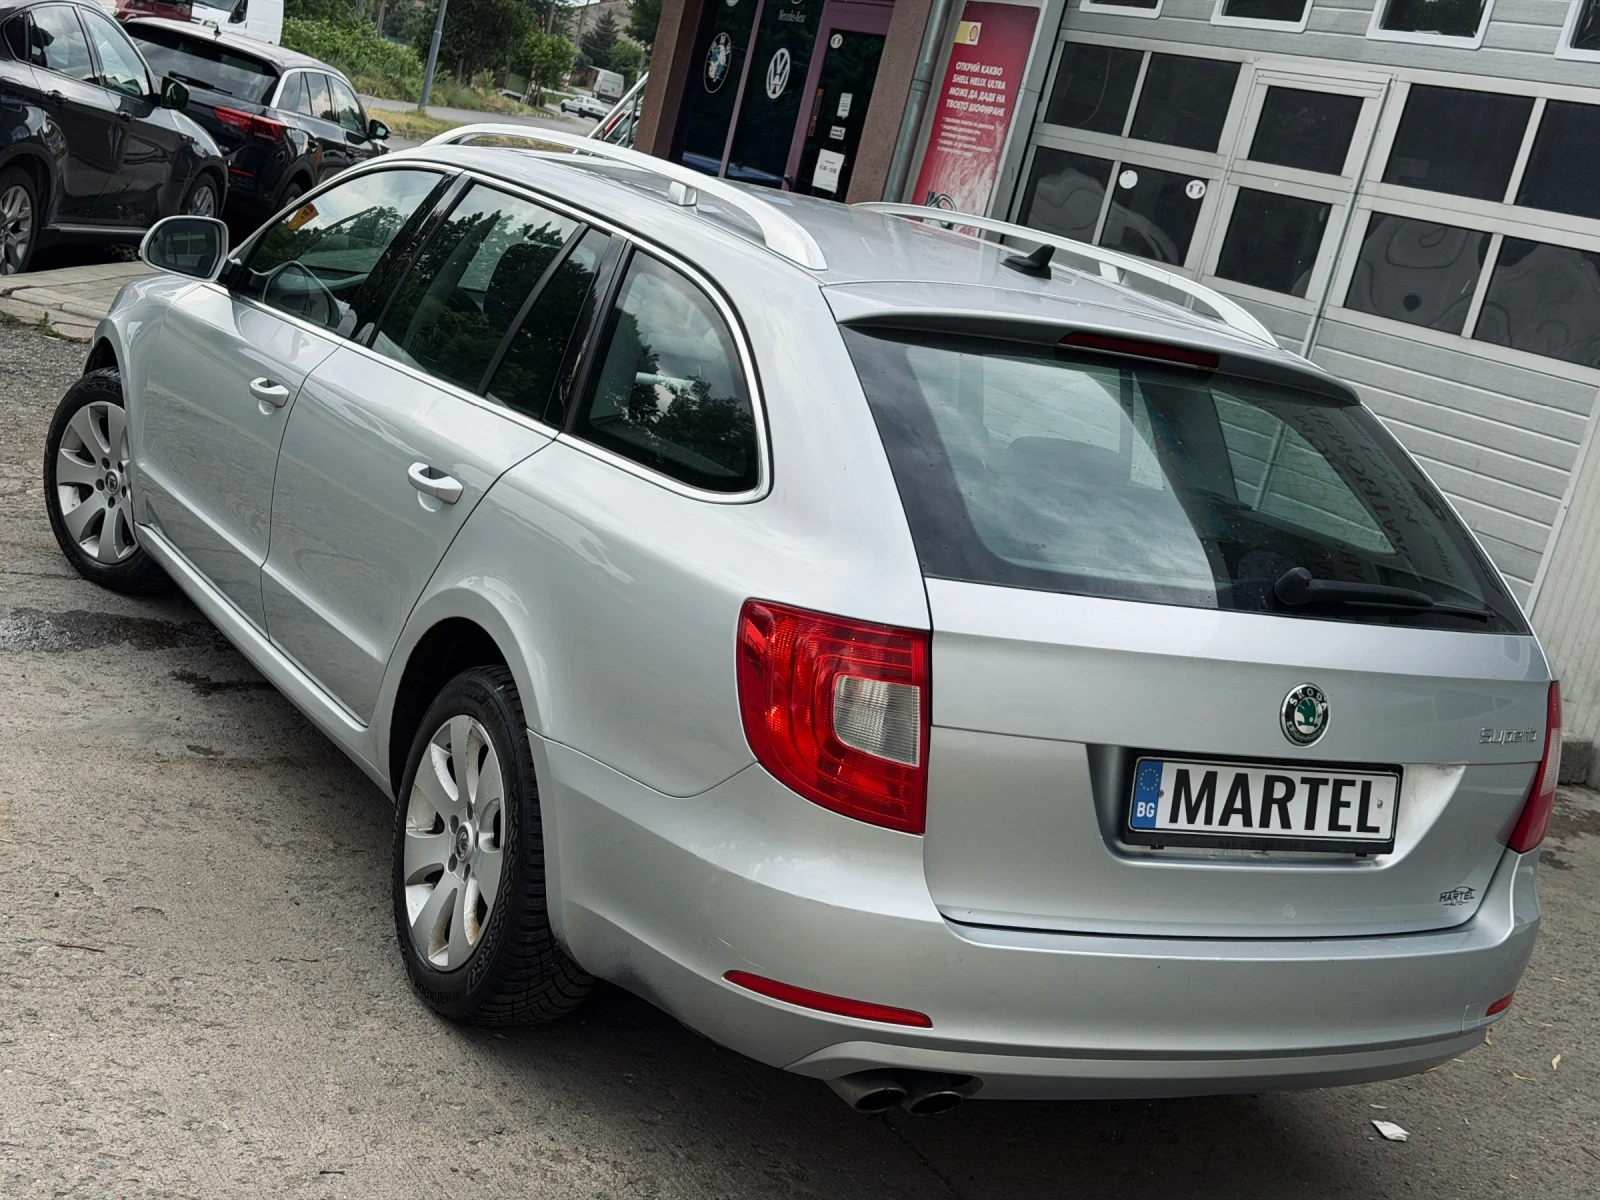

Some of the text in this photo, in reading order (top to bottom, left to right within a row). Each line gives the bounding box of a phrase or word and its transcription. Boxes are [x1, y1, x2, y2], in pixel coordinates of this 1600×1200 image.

[955, 61, 1003, 76] ОТКРИЙ КАКВО
[952, 73, 1006, 90] SHELL HELIX ULTRA
[949, 87, 1006, 104] МОЖЕ ДА ДАДЕ НА
[946, 99, 1005, 117] ТВОЕТО ШОФИРАНЕ
[1136, 801, 1156, 818] BG
[1168, 768, 1381, 834] MARTEL
[1439, 890, 1475, 903] MARTEL
